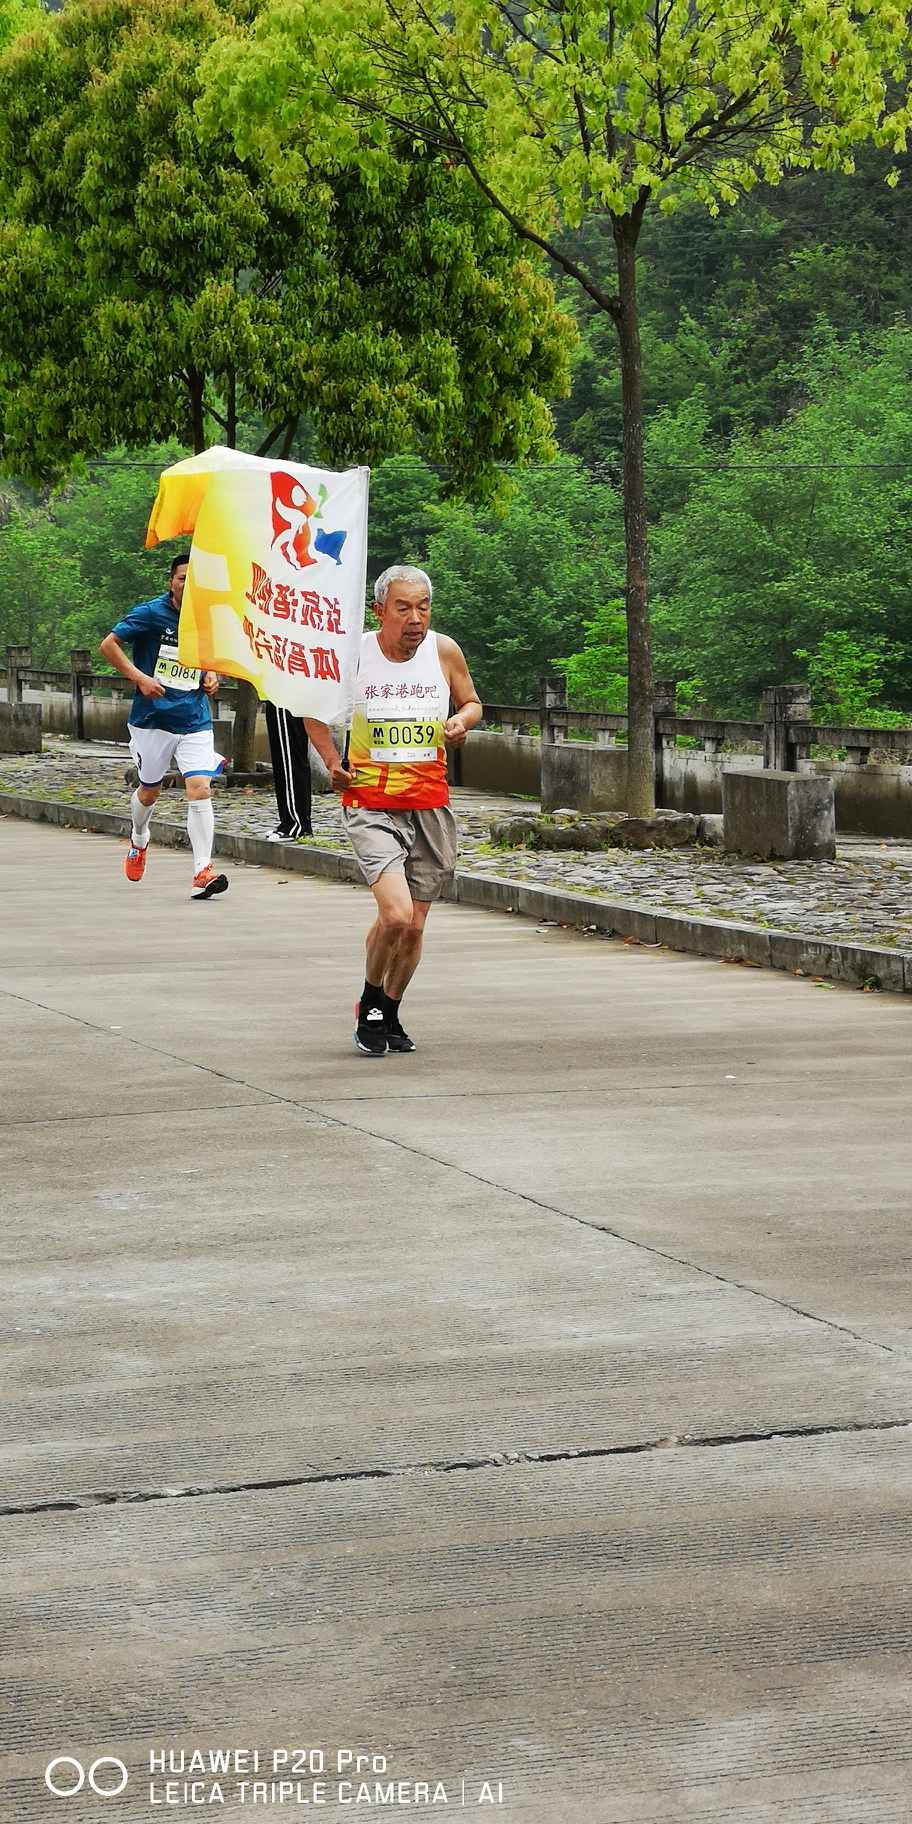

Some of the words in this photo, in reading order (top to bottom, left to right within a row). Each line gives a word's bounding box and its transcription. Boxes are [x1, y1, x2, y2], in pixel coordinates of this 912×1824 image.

[171, 664, 196, 680] 0184
[365, 682, 440, 699] 张家港跑吧
[389, 725, 435, 744] 0039
